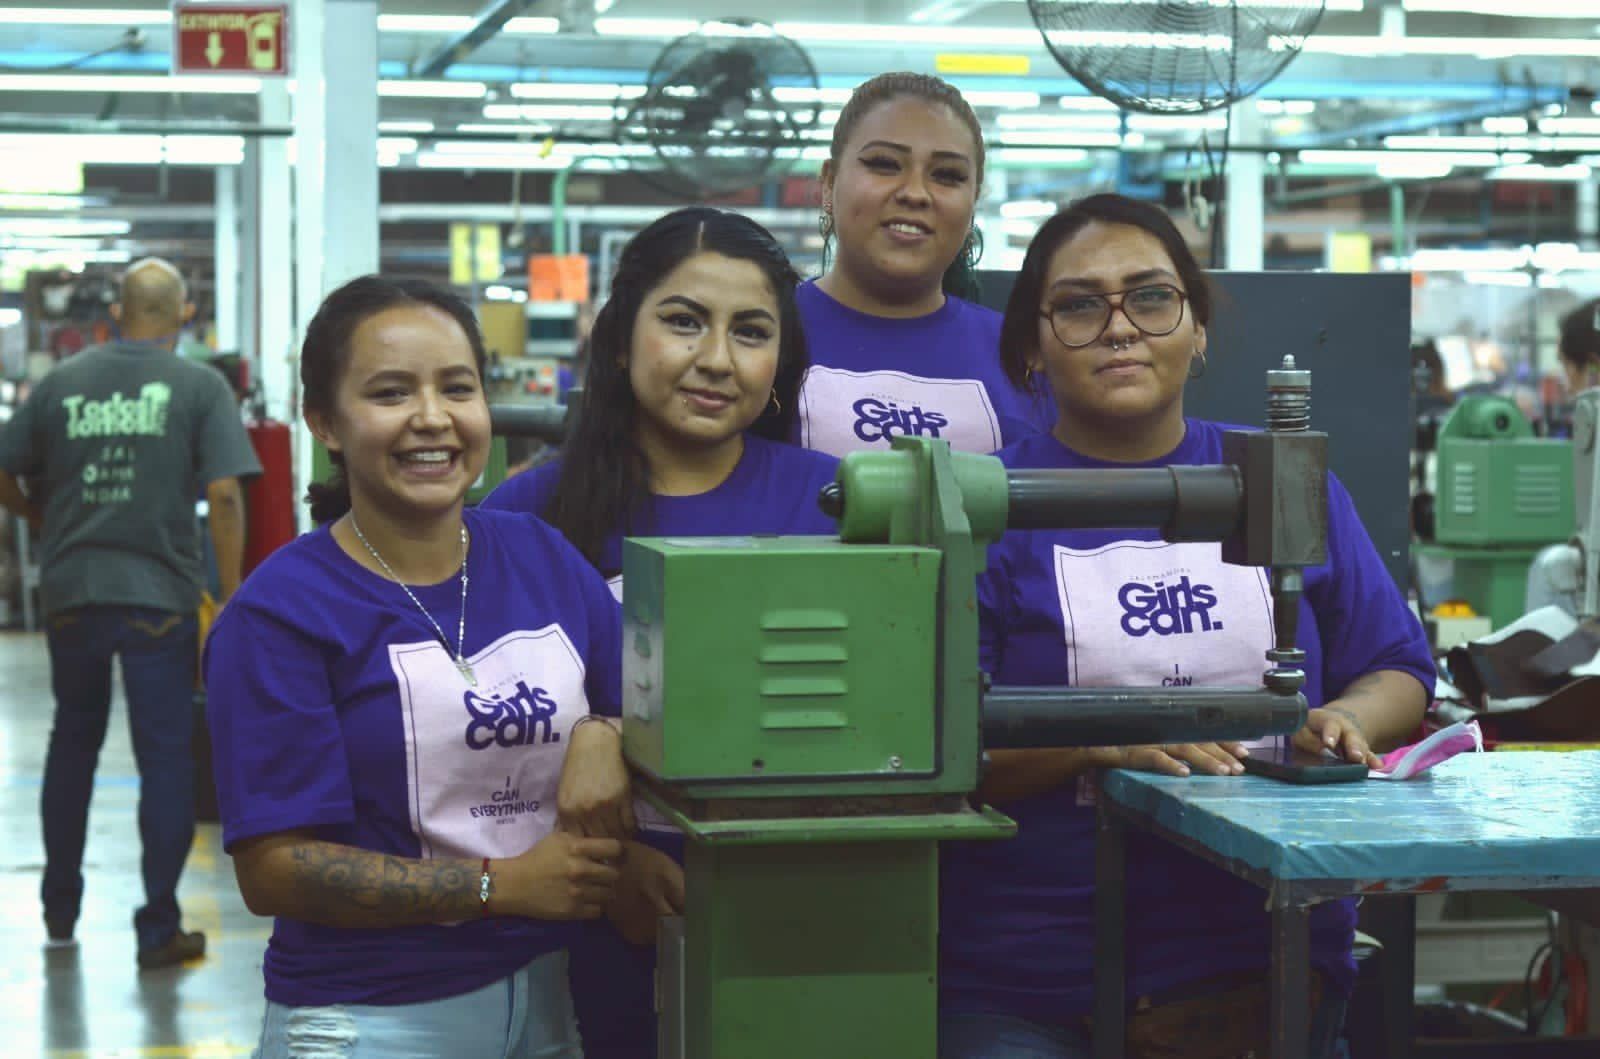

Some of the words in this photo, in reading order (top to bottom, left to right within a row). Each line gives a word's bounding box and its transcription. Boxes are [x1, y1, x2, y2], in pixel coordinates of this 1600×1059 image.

[853, 398, 948, 428] Girls
[854, 418, 950, 448] can
[1118, 576, 1218, 614] Girls
[1120, 602, 1224, 637] can.
[1161, 676, 1193, 687] CAN
[1174, 663, 1179, 675] I
[464, 680, 557, 722] Girls
[465, 713, 561, 751] can.
[491, 789, 520, 802] CAN
[506, 775, 511, 788] I
[470, 800, 540, 818] EVERYTHING
